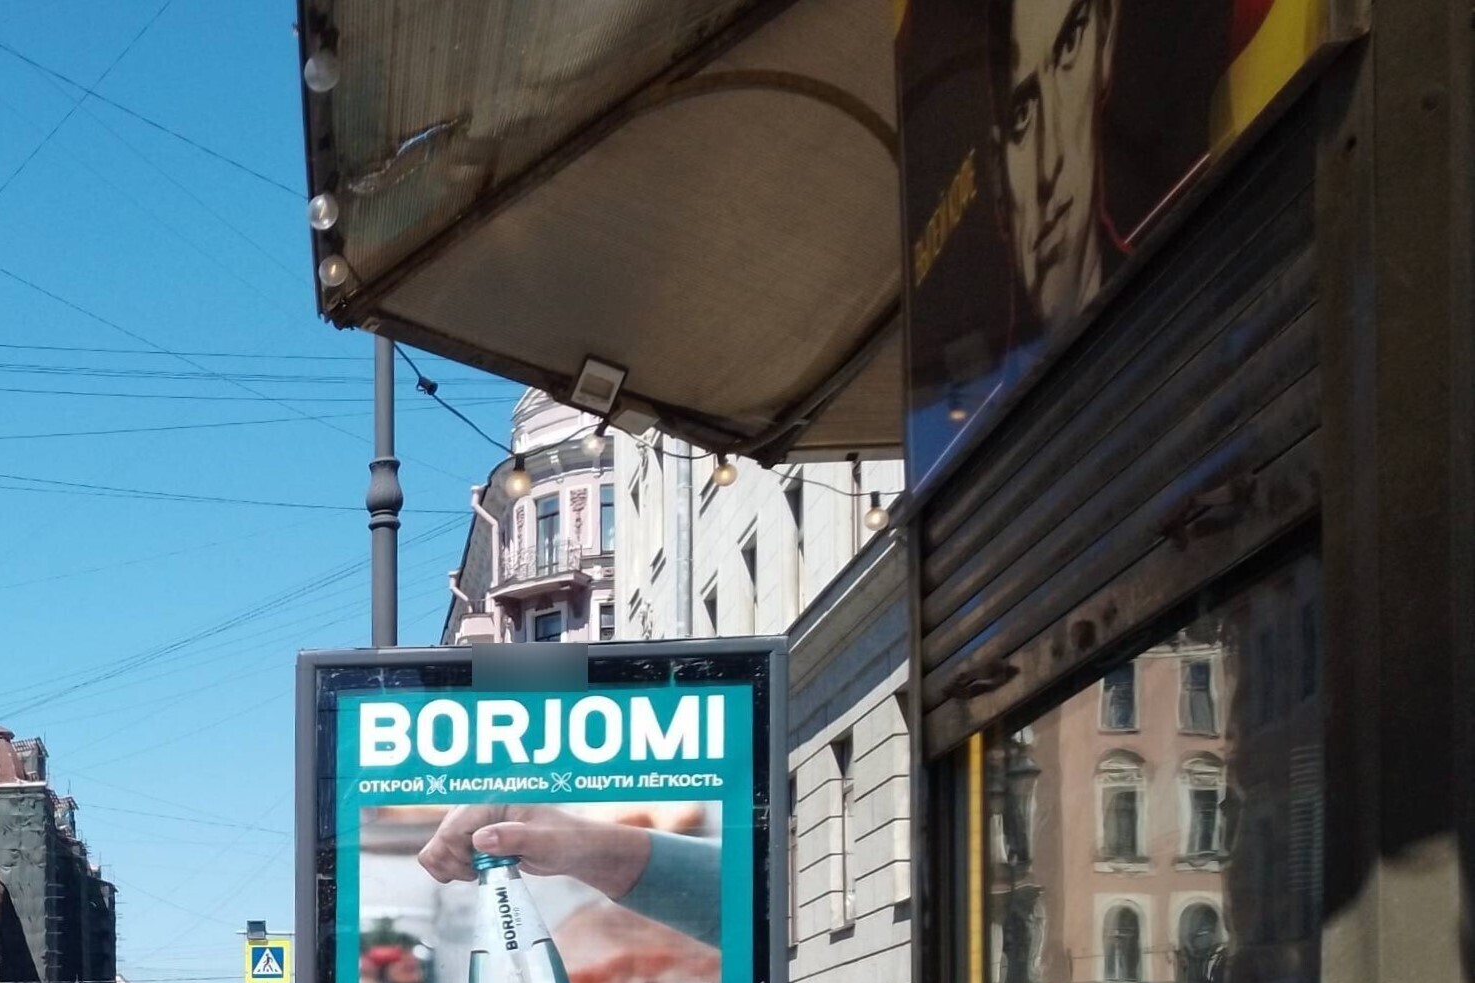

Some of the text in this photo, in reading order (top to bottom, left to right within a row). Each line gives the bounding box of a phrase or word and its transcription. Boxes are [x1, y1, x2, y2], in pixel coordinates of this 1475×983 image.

[358, 694, 725, 767] BORJOMI
[358, 771, 724, 793] ОТКРОЙ НАСЛАДИСЬ ОЩУТИ ЛЁГКОСТЬ
[494, 886, 519, 951] BORJOMI
